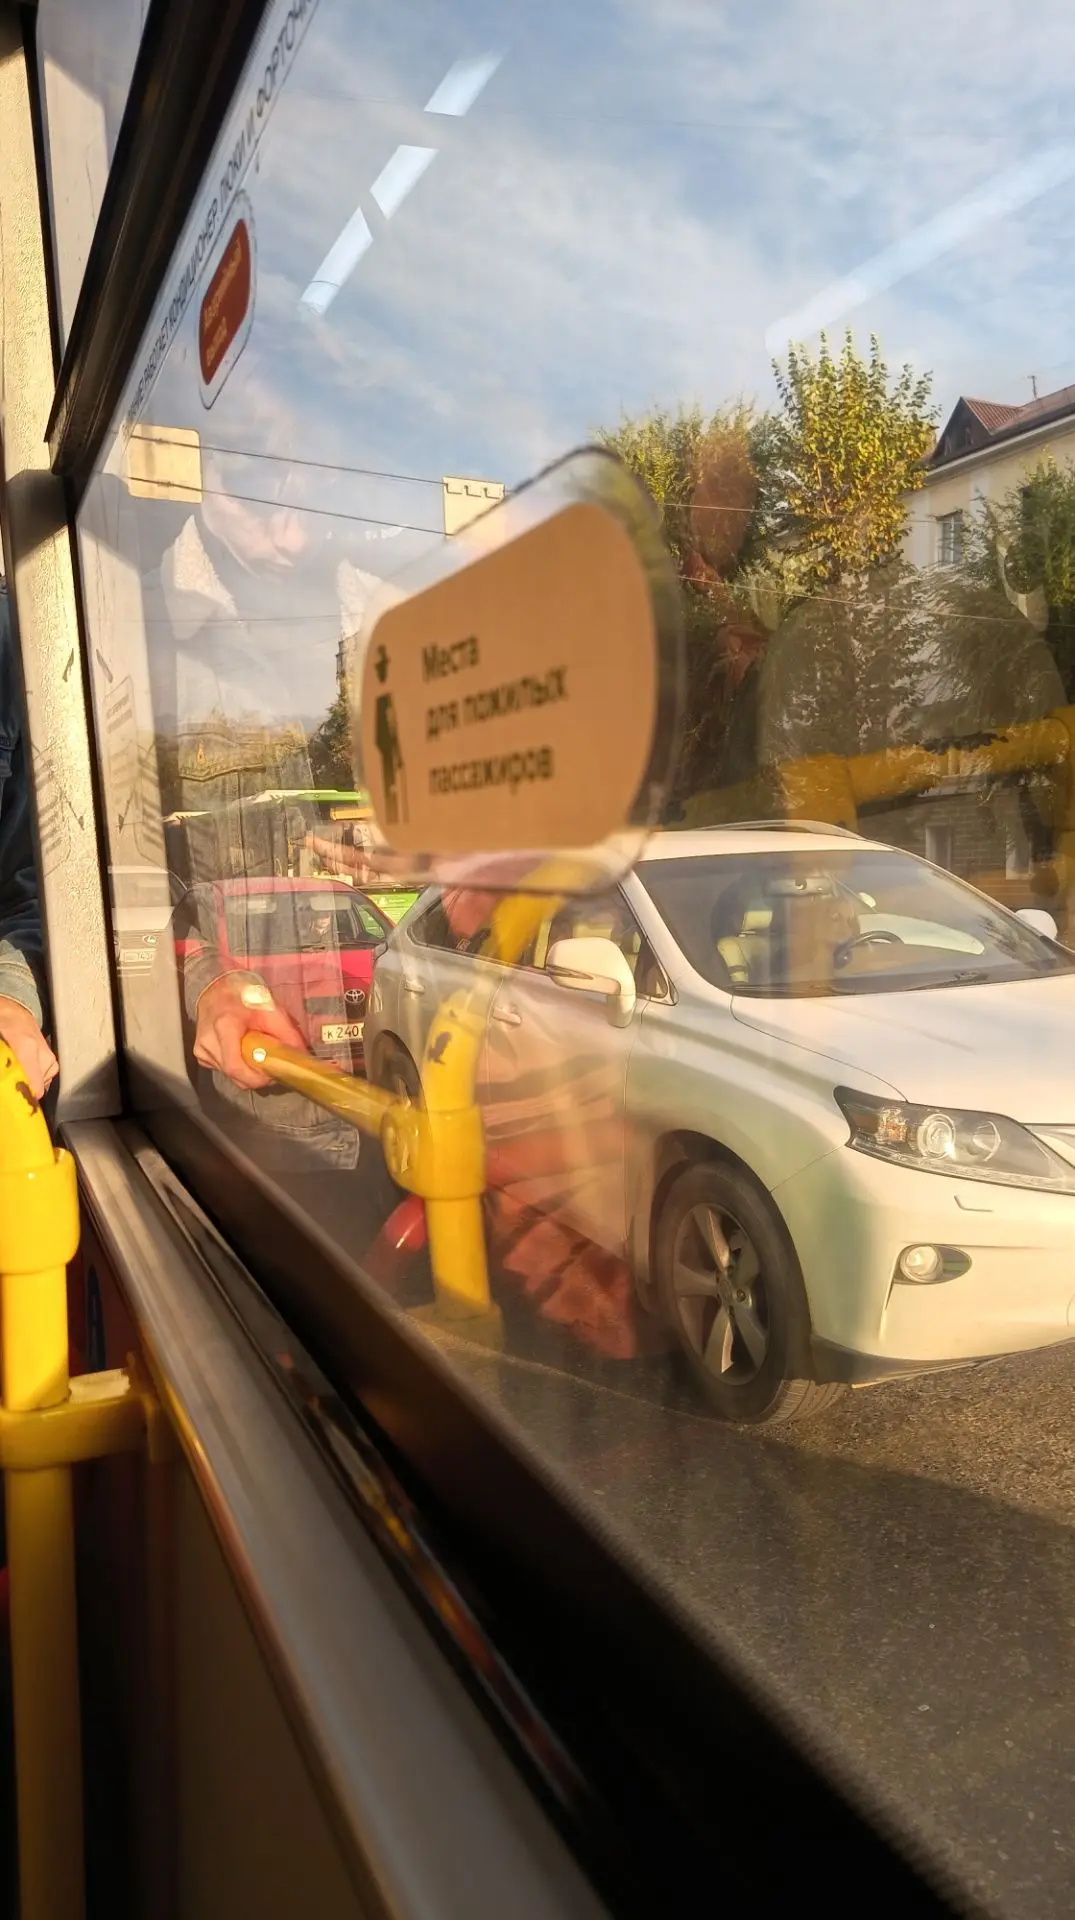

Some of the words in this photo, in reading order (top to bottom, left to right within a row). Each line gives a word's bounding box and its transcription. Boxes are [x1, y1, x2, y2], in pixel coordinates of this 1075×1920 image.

[422, 634, 479, 683] Места
[427, 700, 458, 740] для
[464, 666, 568, 725] пожилых
[429, 746, 554, 797] пассажиров
